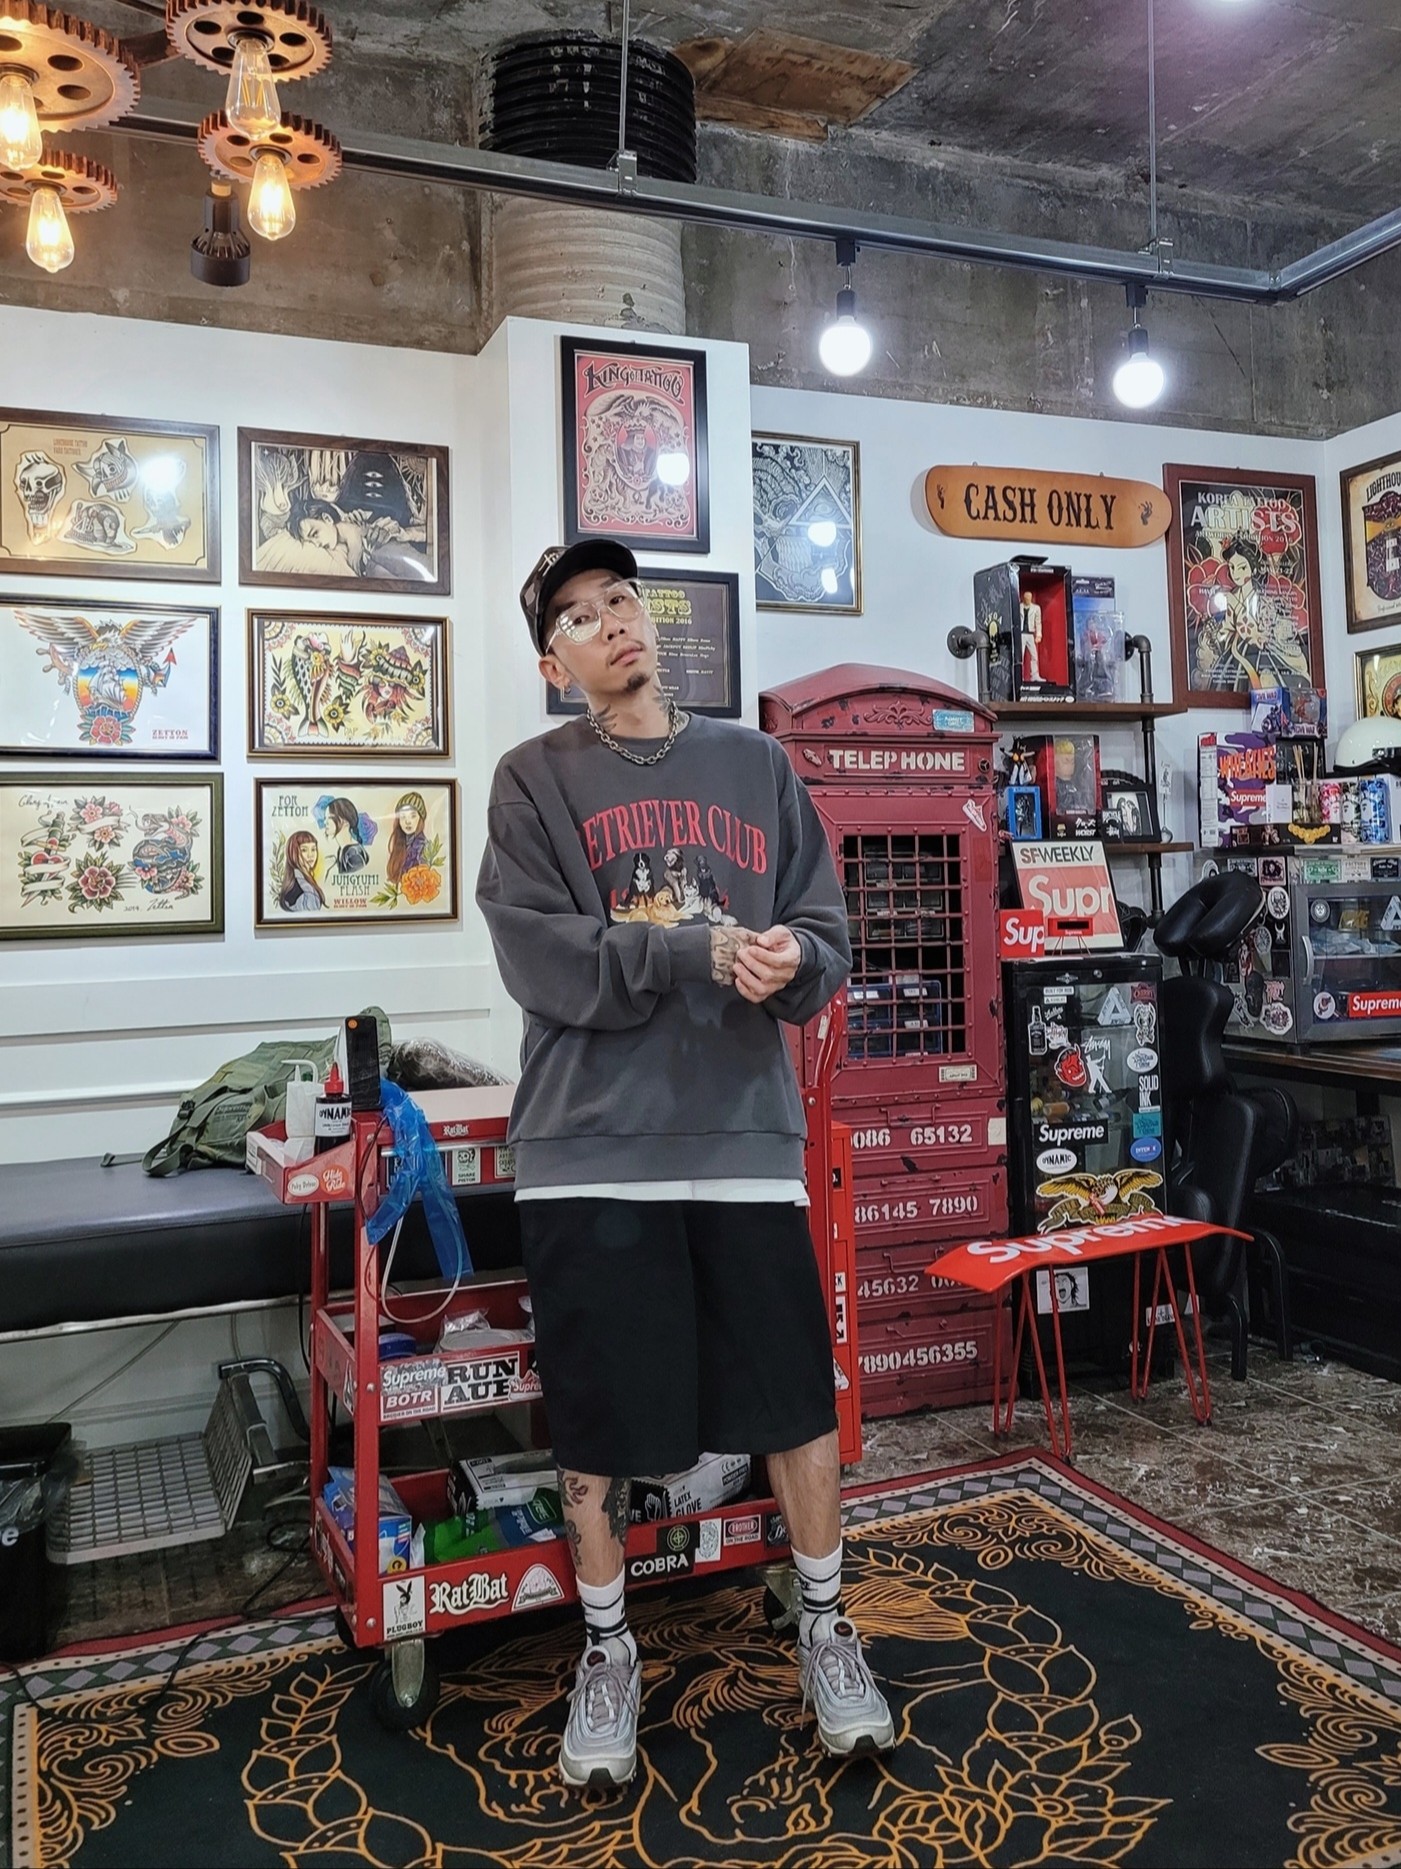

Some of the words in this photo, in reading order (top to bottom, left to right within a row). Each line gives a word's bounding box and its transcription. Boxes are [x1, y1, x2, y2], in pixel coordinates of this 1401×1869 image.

[964, 483, 1038, 524] CASH
[1047, 489, 1117, 531] ONLY
[1191, 505, 1297, 533] ARTISTS
[828, 749, 966, 771] TELEPHONE
[271, 806, 308, 817] ZETTON
[279, 795, 298, 806] FOR
[707, 805, 767, 875] CLUB
[340, 886, 370, 896] FLASH
[1139, 1074, 1159, 1092] SOLID
[1139, 1091, 1152, 1107] INK
[851, 1128, 891, 1149] 086
[910, 1124, 973, 1146] 65132
[1039, 1124, 1105, 1146] Supreme
[1042, 1154, 1072, 1166] DYNAMIC
[929, 1195, 978, 1216] 7890
[967, 1216, 1196, 1264] Suprem
[857, 1274, 919, 1299] 45632
[383, 1366, 447, 1389] Supreme
[448, 1357, 520, 1385] RUN
[386, 1389, 432, 1409] BOTR
[674, 1491, 692, 1508] LATEX
[676, 1498, 702, 1517] GLOVE
[630, 1553, 690, 1577] COBRA
[429, 1573, 509, 1614] RatBat
[387, 1619, 424, 1635] PLUGBOY
